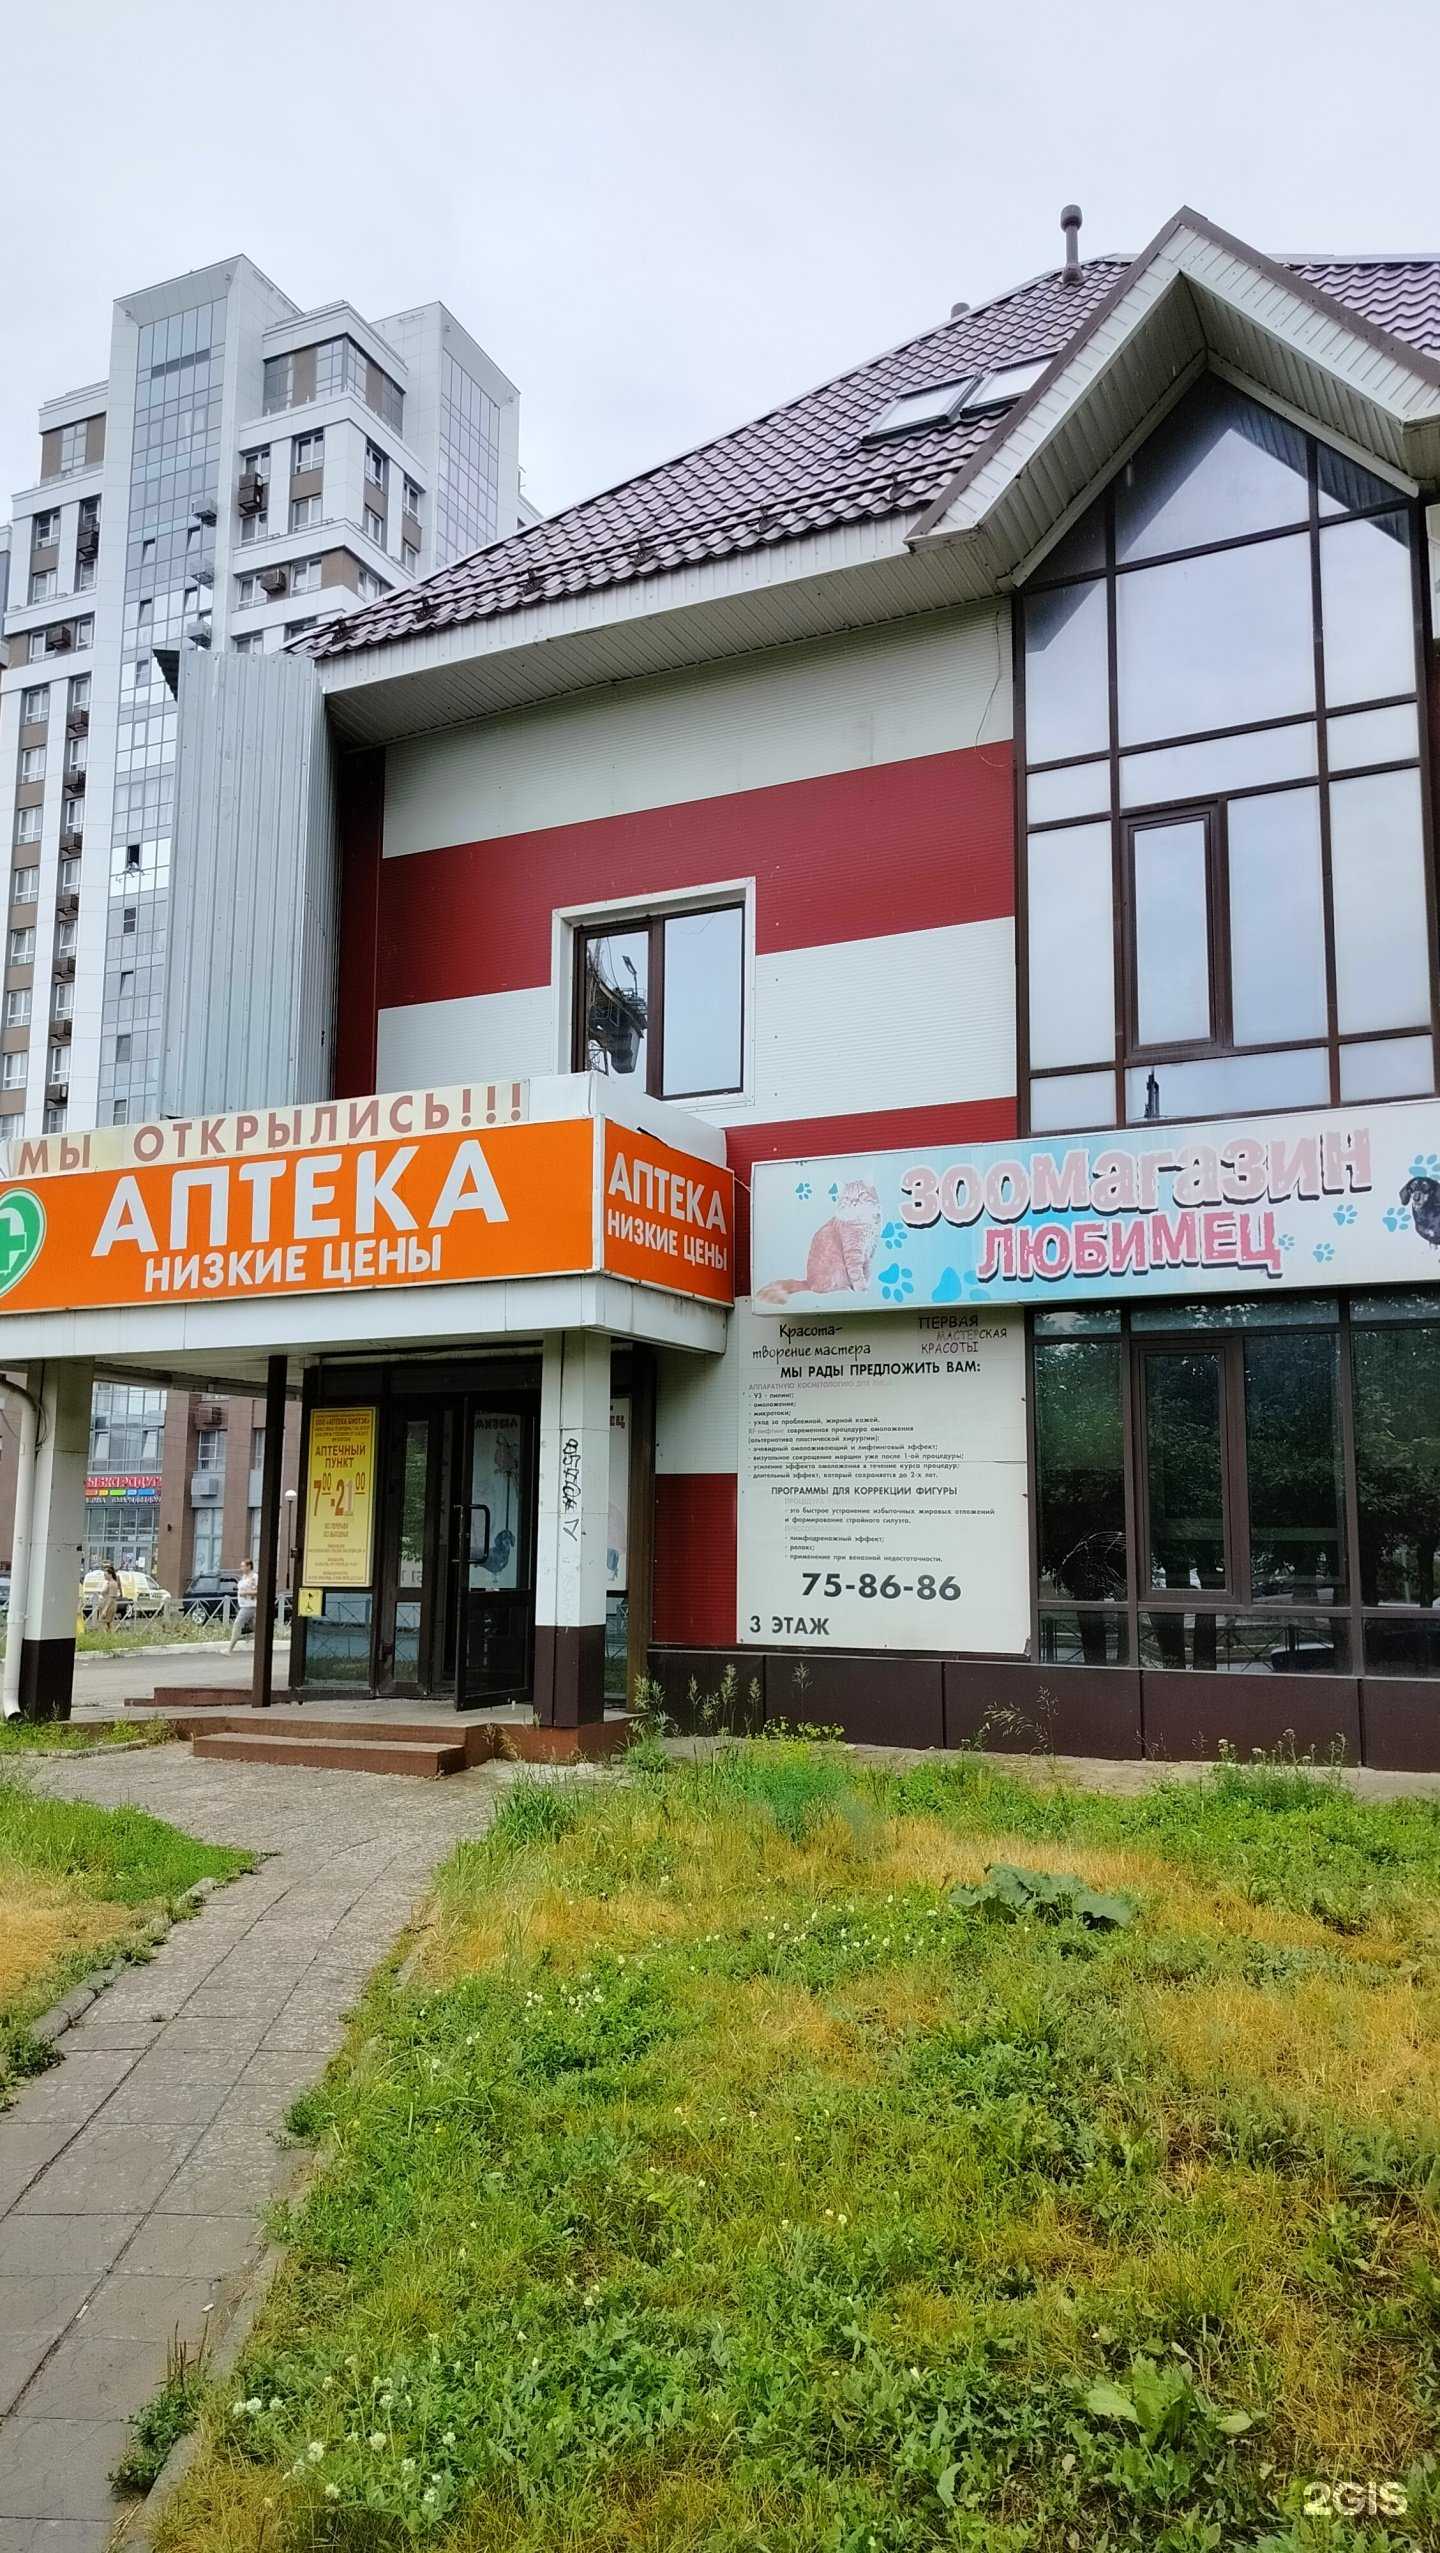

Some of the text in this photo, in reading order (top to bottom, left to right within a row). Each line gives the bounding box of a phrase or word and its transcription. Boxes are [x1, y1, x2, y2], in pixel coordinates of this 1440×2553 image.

[18, 1082, 523, 1176] МЫ ОТКРЫЛИСЬ!!!
[92, 1140, 509, 1257] АПТЕКА
[608, 1150, 727, 1236] АПТЕКА
[607, 1207, 728, 1272] НИЗКИЕ ЦЕНЫ
[977, 1210, 1284, 1281] ЛЮБИМЕЦ
[145, 1234, 441, 1293] НИЗКИЕ ЦЕНЫ
[919, 1315, 979, 1330] ПЕРВАЯ
[779, 1323, 843, 1344] Красота-
[937, 1328, 1007, 1341] МАСТЕРСКАЯ
[752, 1343, 871, 1364] творение мастера
[921, 1341, 979, 1354] КРАСОТЫ
[781, 1360, 981, 1378] МЫ РАДЫ ПРЕДЛОЖИТЬ ВАМ:
[315, 1444, 366, 1457] АПТЕЧНЫЙ
[325, 1457, 354, 1469] ПУНКТ
[771, 1486, 958, 1497] ПРОГРАММЫ ДЛЯ КОРРЕКЦИИ ФИГУРЫ
[802, 1573, 962, 1601] 75-86-86
[750, 1616, 830, 1635] 3 ЭТАЖ
